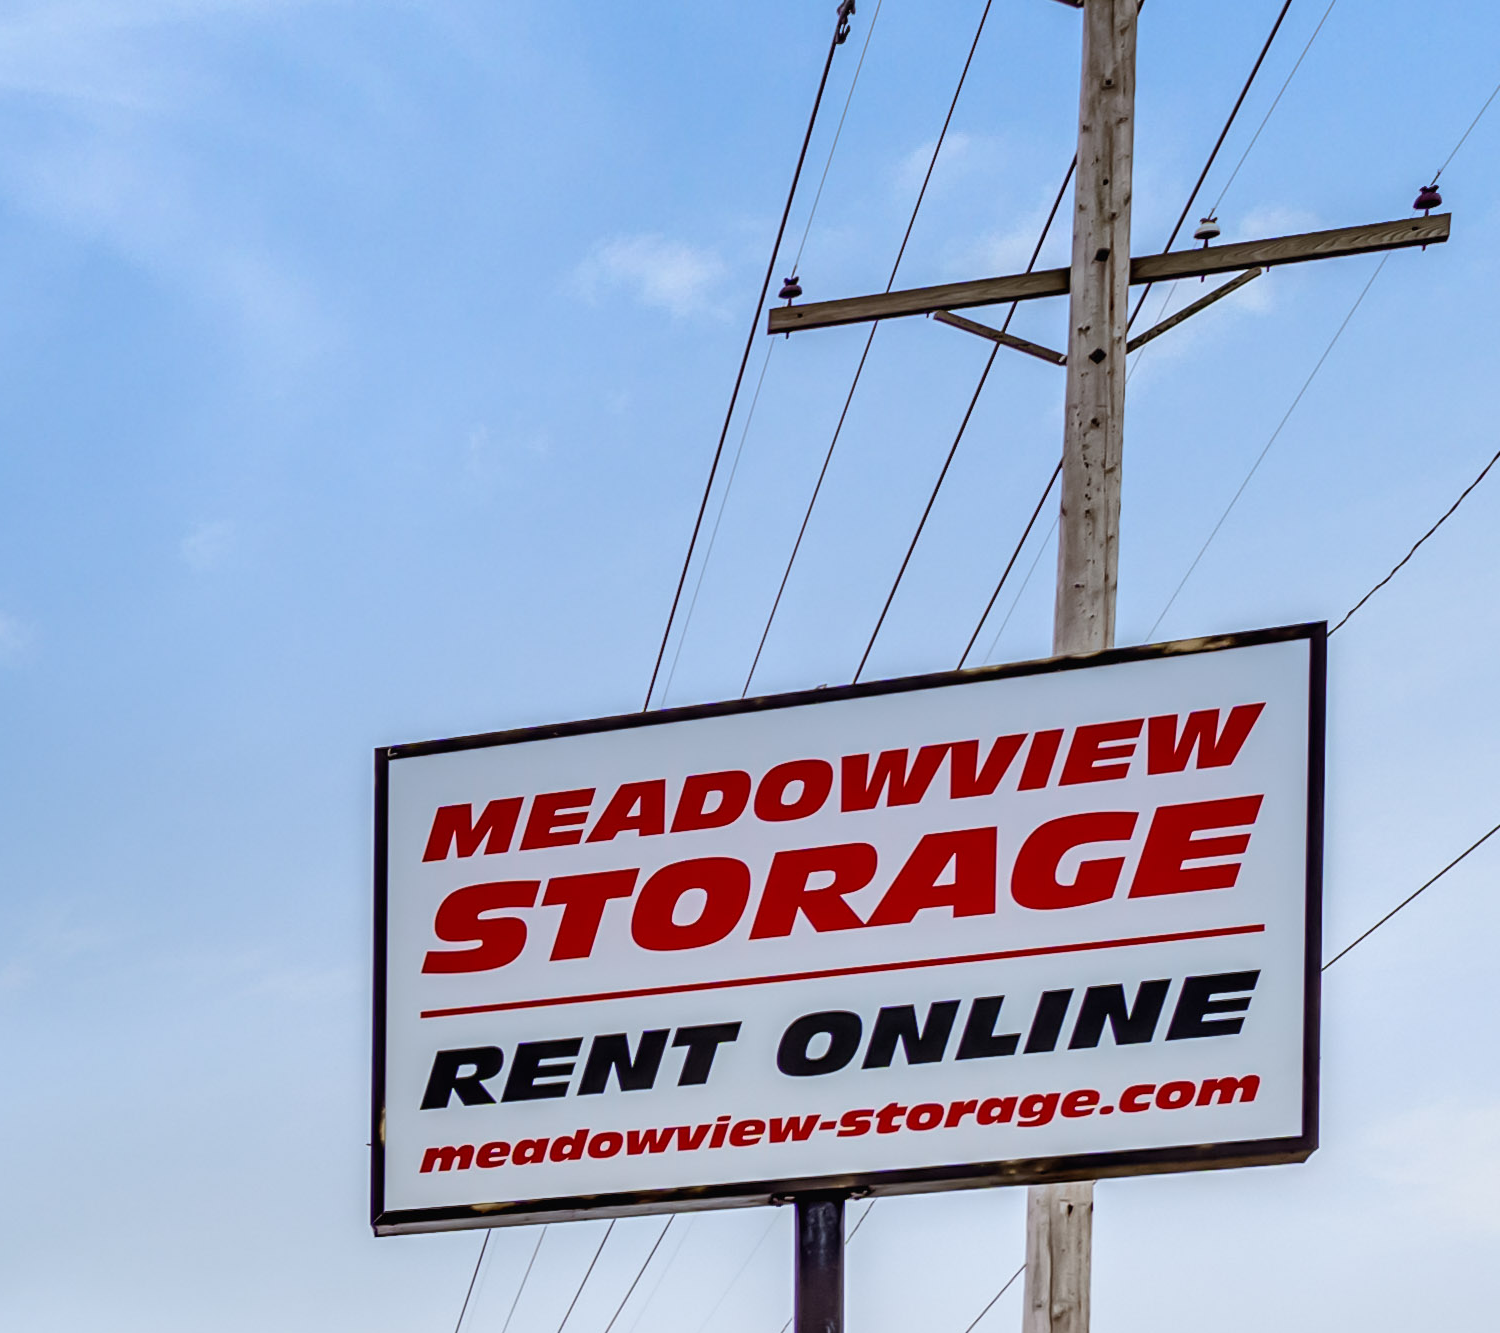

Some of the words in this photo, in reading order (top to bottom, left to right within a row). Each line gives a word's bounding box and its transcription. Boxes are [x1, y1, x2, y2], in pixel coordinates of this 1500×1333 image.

[423, 703, 1265, 862] MEADOWVIEW
[422, 795, 1264, 974] STORAGE
[420, 1021, 742, 1110] RENT
[776, 969, 1261, 1078] ONLINE
[420, 1074, 1260, 1173] meadowview-storage.com
